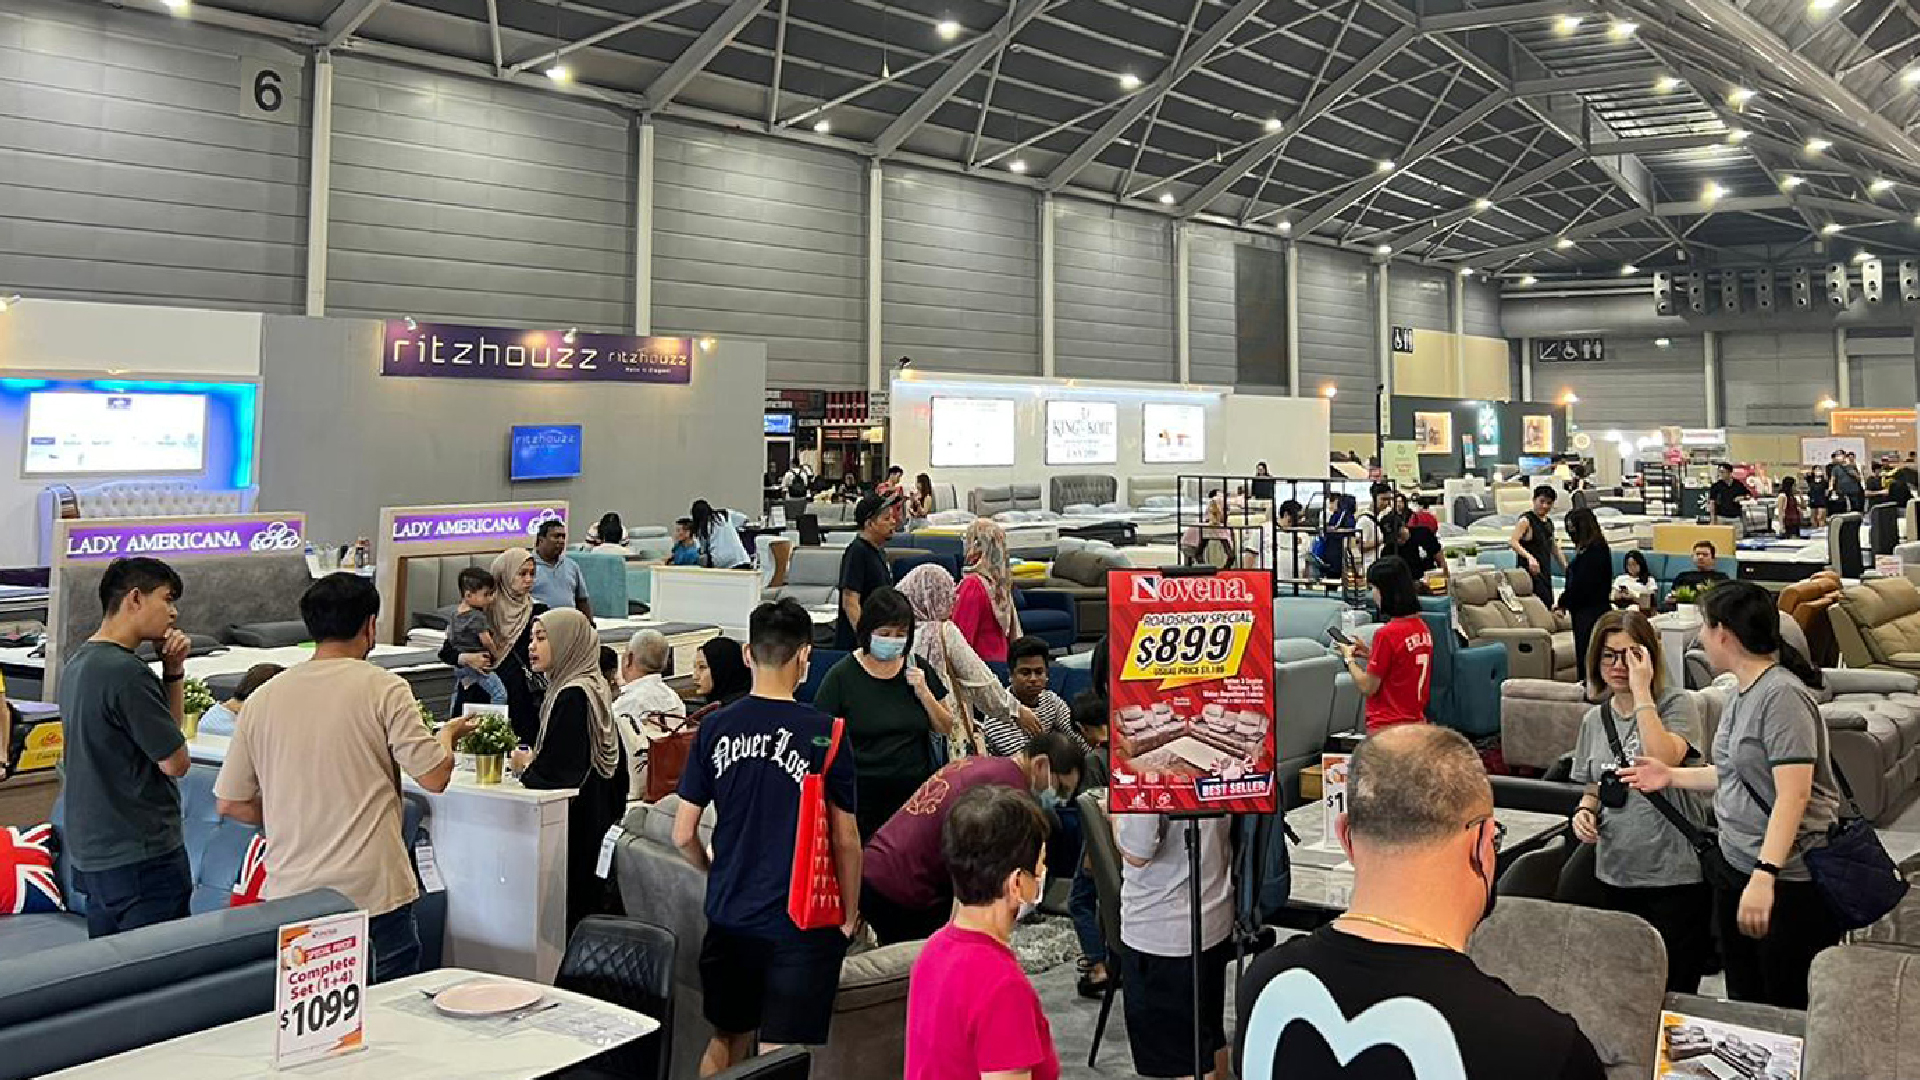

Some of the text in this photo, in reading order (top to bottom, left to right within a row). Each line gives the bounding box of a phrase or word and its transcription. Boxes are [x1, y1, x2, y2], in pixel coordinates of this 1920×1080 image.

[255, 70, 281, 111] 6
[393, 334, 597, 370] ritzhouzz
[608, 350, 687, 366] ritzhouzz
[393, 516, 521, 537] LADY AMERICANA
[67, 531, 241, 554] LADY AMERICANA
[1144, 610, 1252, 626] ROADSHOW SPECIAL
[1136, 624, 1233, 666] $899
[1415, 653, 1429, 702] 7
[712, 727, 811, 784] Never Los
[1201, 780, 1266, 797] BEST SELLER
[289, 956, 356, 985] Complete
[290, 970, 353, 1000] Set (1+4)
[280, 984, 360, 1036] $1099
